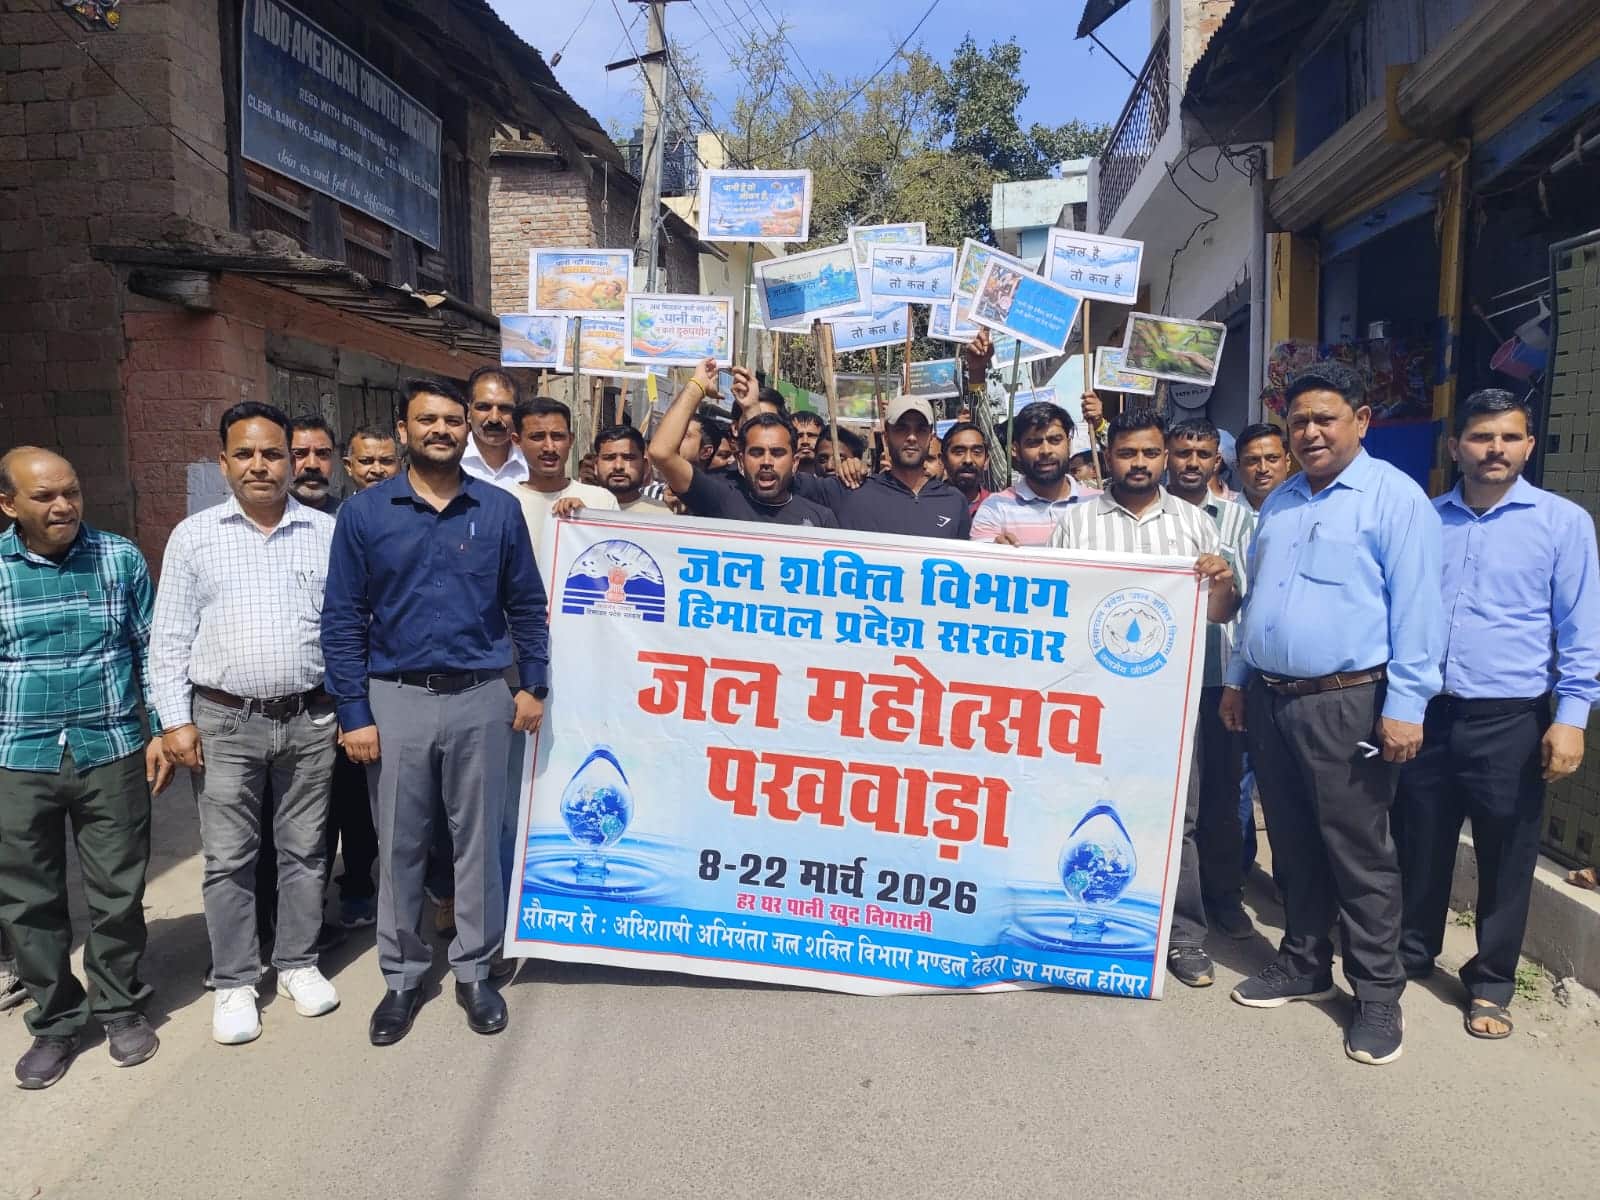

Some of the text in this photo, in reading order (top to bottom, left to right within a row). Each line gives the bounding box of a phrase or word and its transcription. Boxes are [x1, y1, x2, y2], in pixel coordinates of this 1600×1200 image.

[254, 0, 357, 97] INDO-AMERICAN
[320, 99, 341, 121] WITH
[278, 147, 297, 169] Join
[885, 256, 904, 266] जल
[1066, 245, 1087, 257] जल
[889, 277, 902, 289] तो
[907, 280, 925, 290] कल
[1070, 268, 1083, 281] तो
[1088, 273, 1109, 286] कल
[664, 311, 688, 326] पानी
[851, 326, 863, 339] तो
[868, 324, 887, 337] कल
[678, 547, 1069, 618] जल शक्ति विभाग
[678, 588, 1067, 664] हिमाचल प्रदेश सरकार
[637, 650, 1105, 765] जल महोत्सव
[705, 745, 1012, 861] पखवाड़ा
[698, 848, 978, 915] 8-22 मार्च 2026
[736, 892, 933, 933] हर घर पानी खुद निगरानी
[522, 897, 577, 933] सौजन्य
[580, 904, 597, 935] से
[613, 909, 693, 945] अधिशाषी
[695, 917, 769, 952] अभियंता
[772, 932, 802, 957] जल
[804, 929, 855, 963] शक्ति
[857, 934, 913, 972] विभाग
[916, 949, 969, 978] मण्डल
[970, 950, 1009, 977] देहरा
[1010, 957, 1037, 980] उप
[1040, 963, 1094, 989] मण्डल
